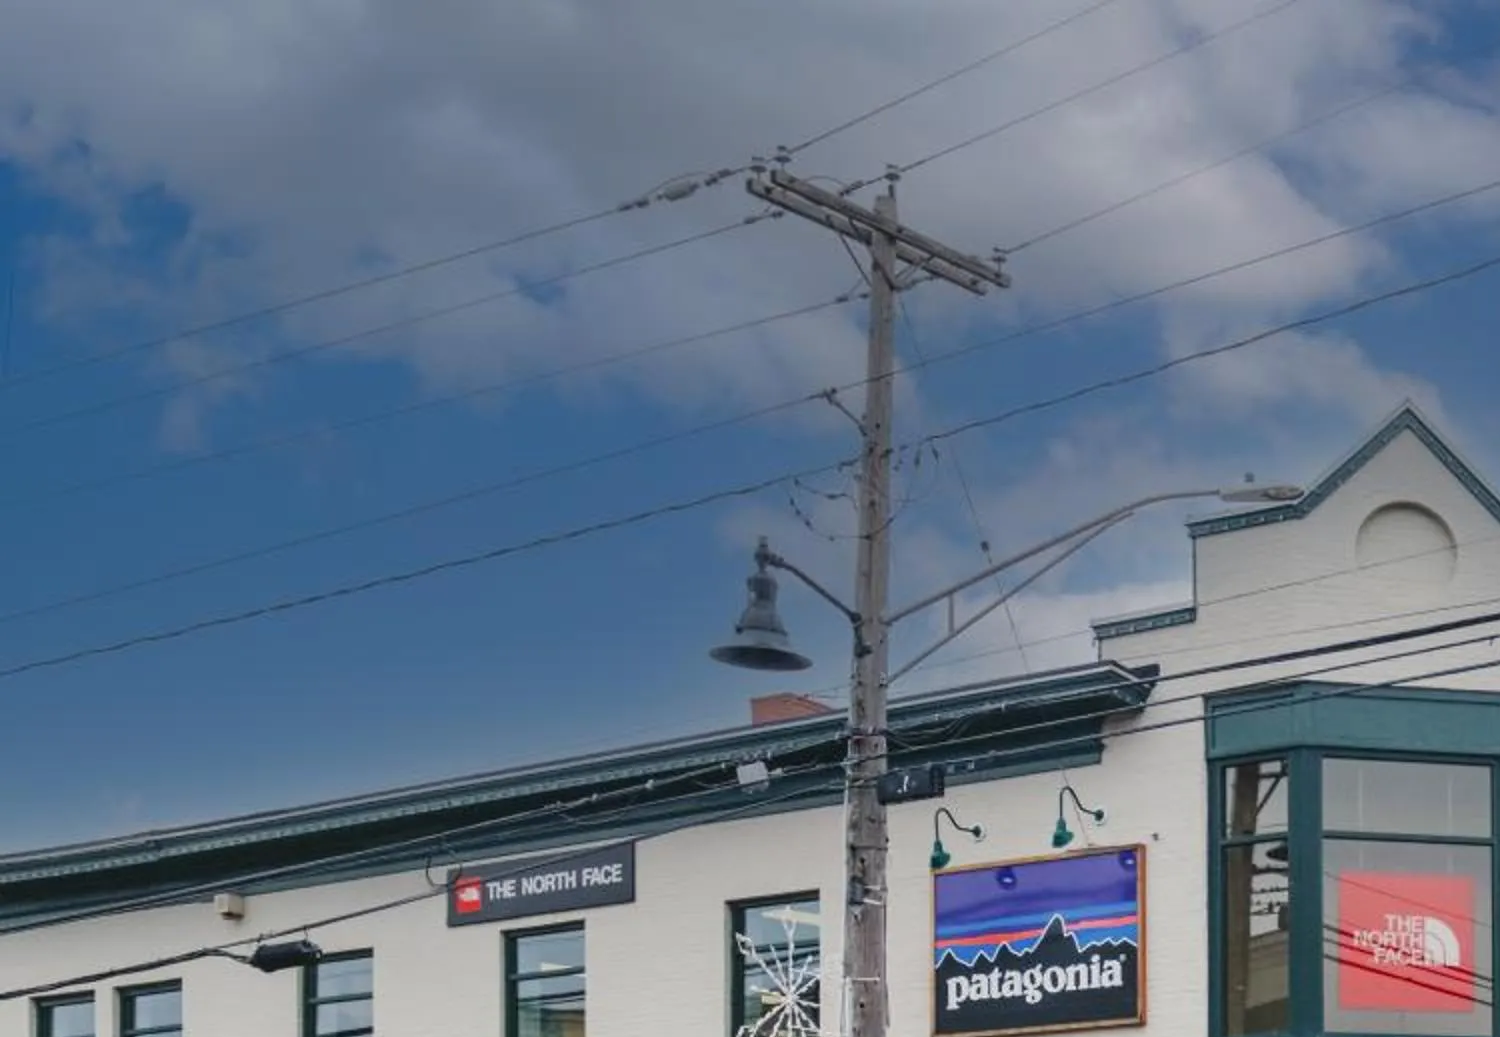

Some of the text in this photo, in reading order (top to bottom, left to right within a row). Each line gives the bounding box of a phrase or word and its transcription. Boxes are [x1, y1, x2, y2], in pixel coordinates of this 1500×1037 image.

[486, 863, 624, 900] THE NORTH FACE
[1384, 914, 1425, 932] THE
[1352, 930, 1425, 949] NORTH
[1373, 946, 1425, 967] FACE
[946, 954, 1124, 1010] patagonia
